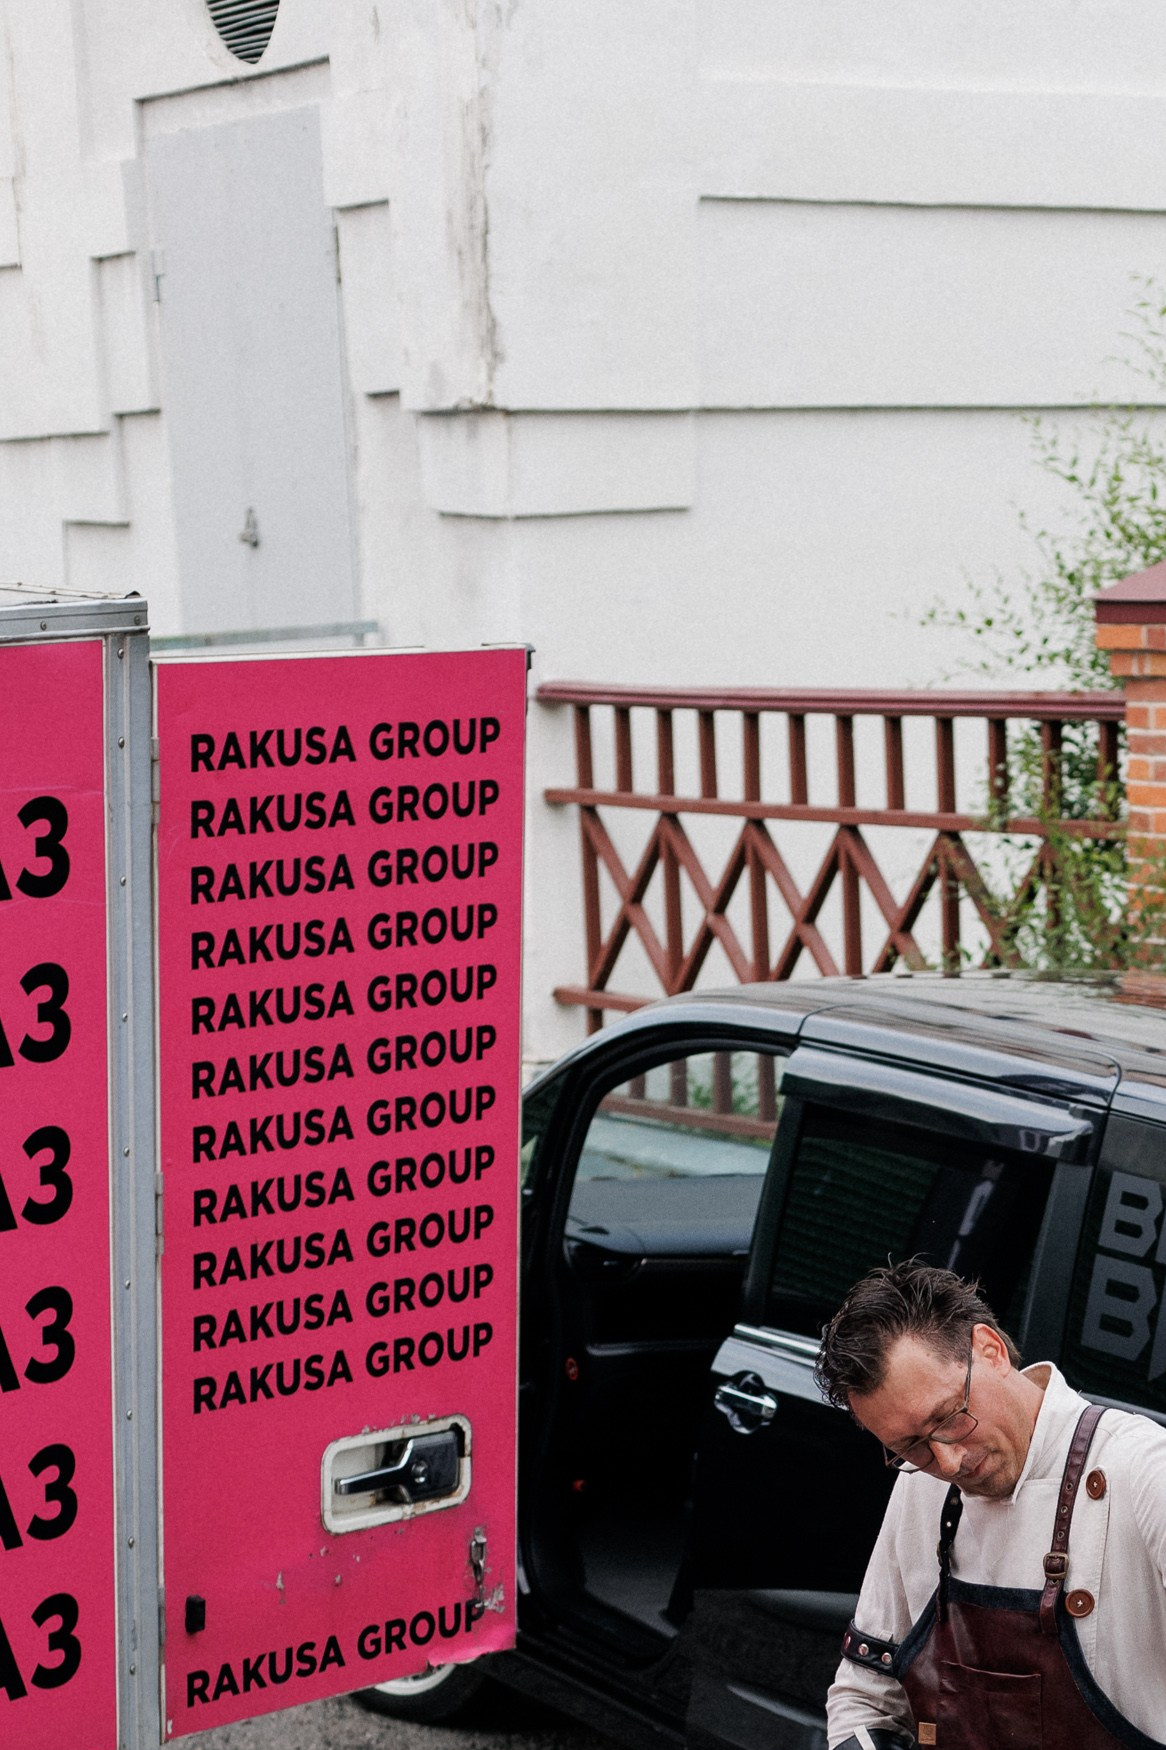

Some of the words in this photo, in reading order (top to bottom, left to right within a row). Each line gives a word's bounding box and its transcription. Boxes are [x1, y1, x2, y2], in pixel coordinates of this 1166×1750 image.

[191, 725, 357, 773] RAKUSA
[369, 716, 501, 761] GROUP
[190, 789, 356, 839] RAKUSA
[368, 779, 500, 825] GROUP
[190, 853, 355, 905] RAKUSA
[367, 841, 499, 888] GROUP
[191, 917, 355, 970] RAKUSA
[367, 903, 498, 951] GROUP
[191, 980, 355, 1035] RAKUSA
[367, 964, 497, 1013] GROUP
[191, 1043, 354, 1100] RAKUSA
[366, 1024, 497, 1075] GROUP
[192, 1105, 354, 1164] RAKUSA
[366, 1085, 496, 1136] GROUP
[193, 1167, 355, 1227] RAKUSA
[367, 1144, 495, 1197] GROUP
[193, 1228, 354, 1290] RAKUSA
[366, 1204, 494, 1258] GROUP
[193, 1289, 353, 1353] RAKUSA
[365, 1263, 494, 1318] GROUP
[193, 1349, 353, 1415] RAKUSA
[365, 1322, 493, 1378] GROUP
[186, 1635, 346, 1708] RAKUSA
[357, 1598, 485, 1661] GROUP
